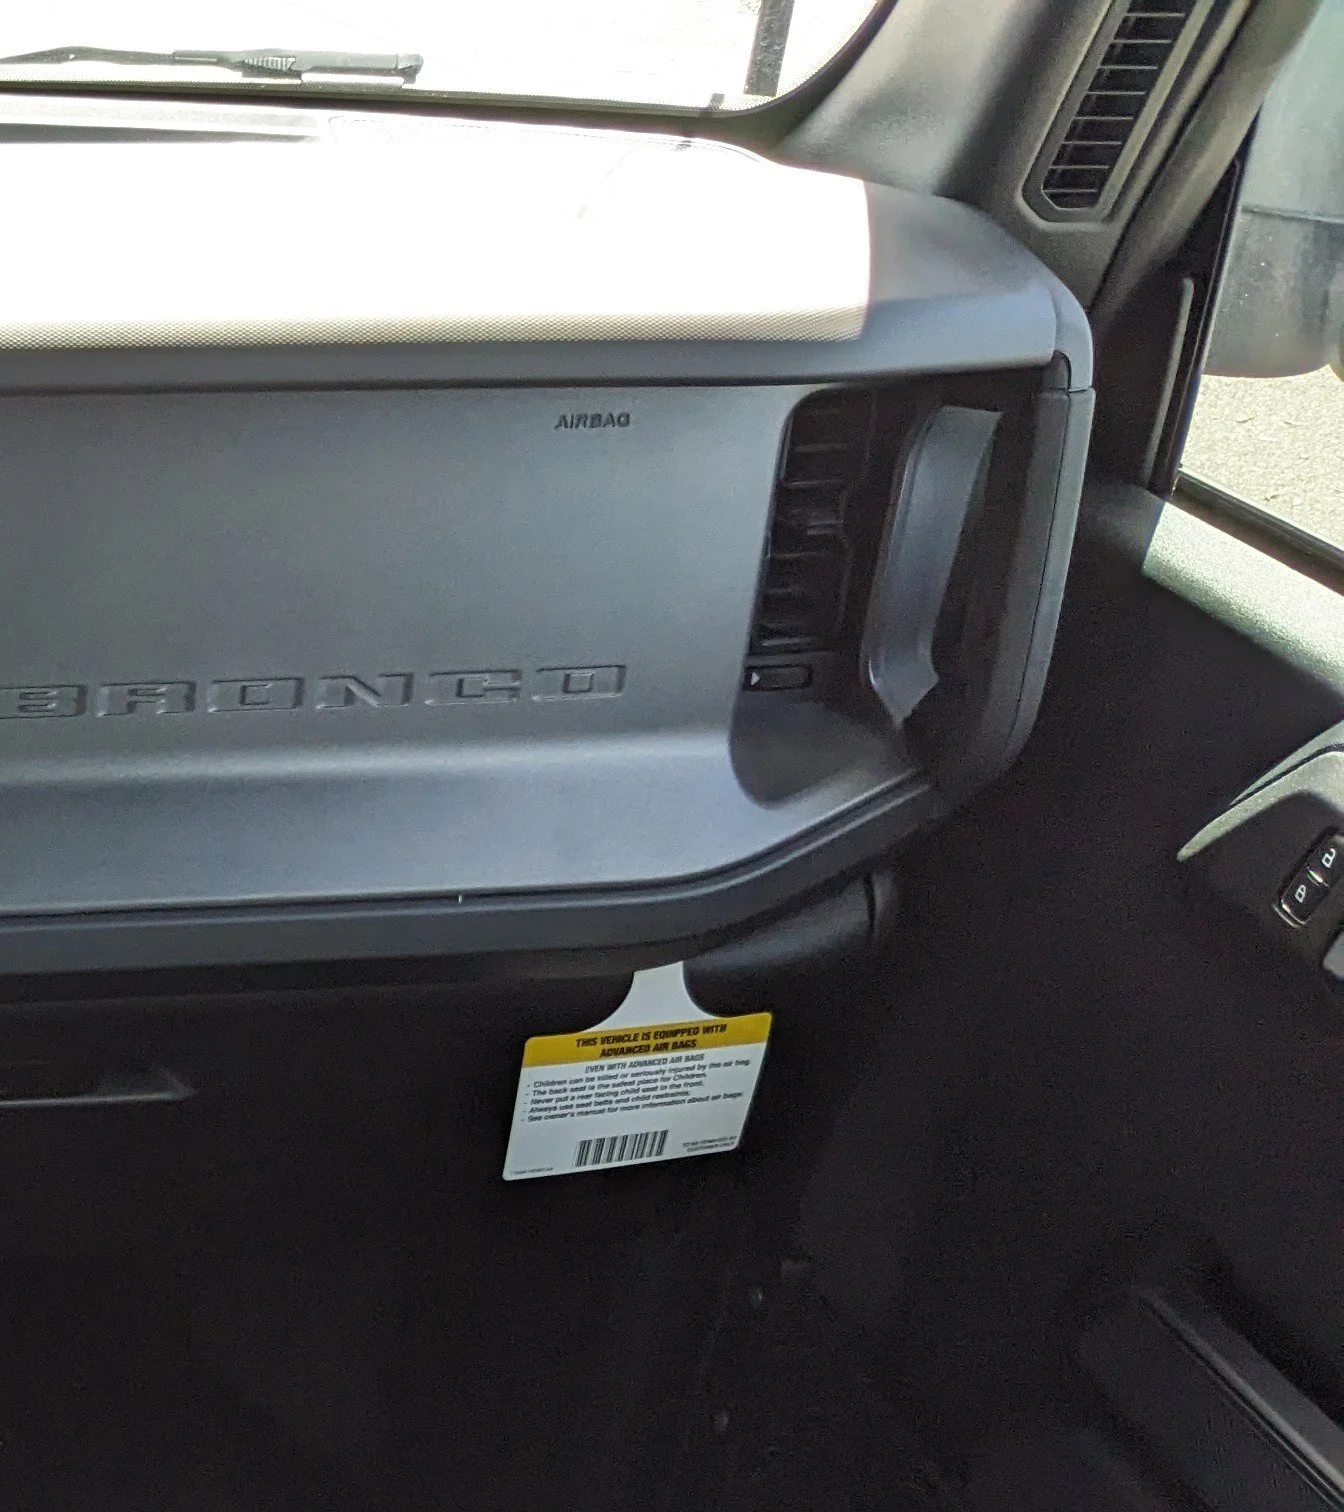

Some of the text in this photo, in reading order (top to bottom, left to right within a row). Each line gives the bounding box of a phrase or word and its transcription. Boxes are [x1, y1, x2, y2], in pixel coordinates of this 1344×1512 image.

[554, 413, 631, 428] AIRBAG
[576, 1023, 728, 1048] THIS VEHICLE IS EQUIPPED WITH
[600, 1039, 697, 1058] ADVANCED AIR BAGS
[607, 1061, 627, 1071] WITH
[628, 1057, 668, 1068] ADVANCED
[669, 1055, 682, 1064] AIR
[684, 1053, 705, 1062] BAGS
[533, 1080, 567, 1089] Children
